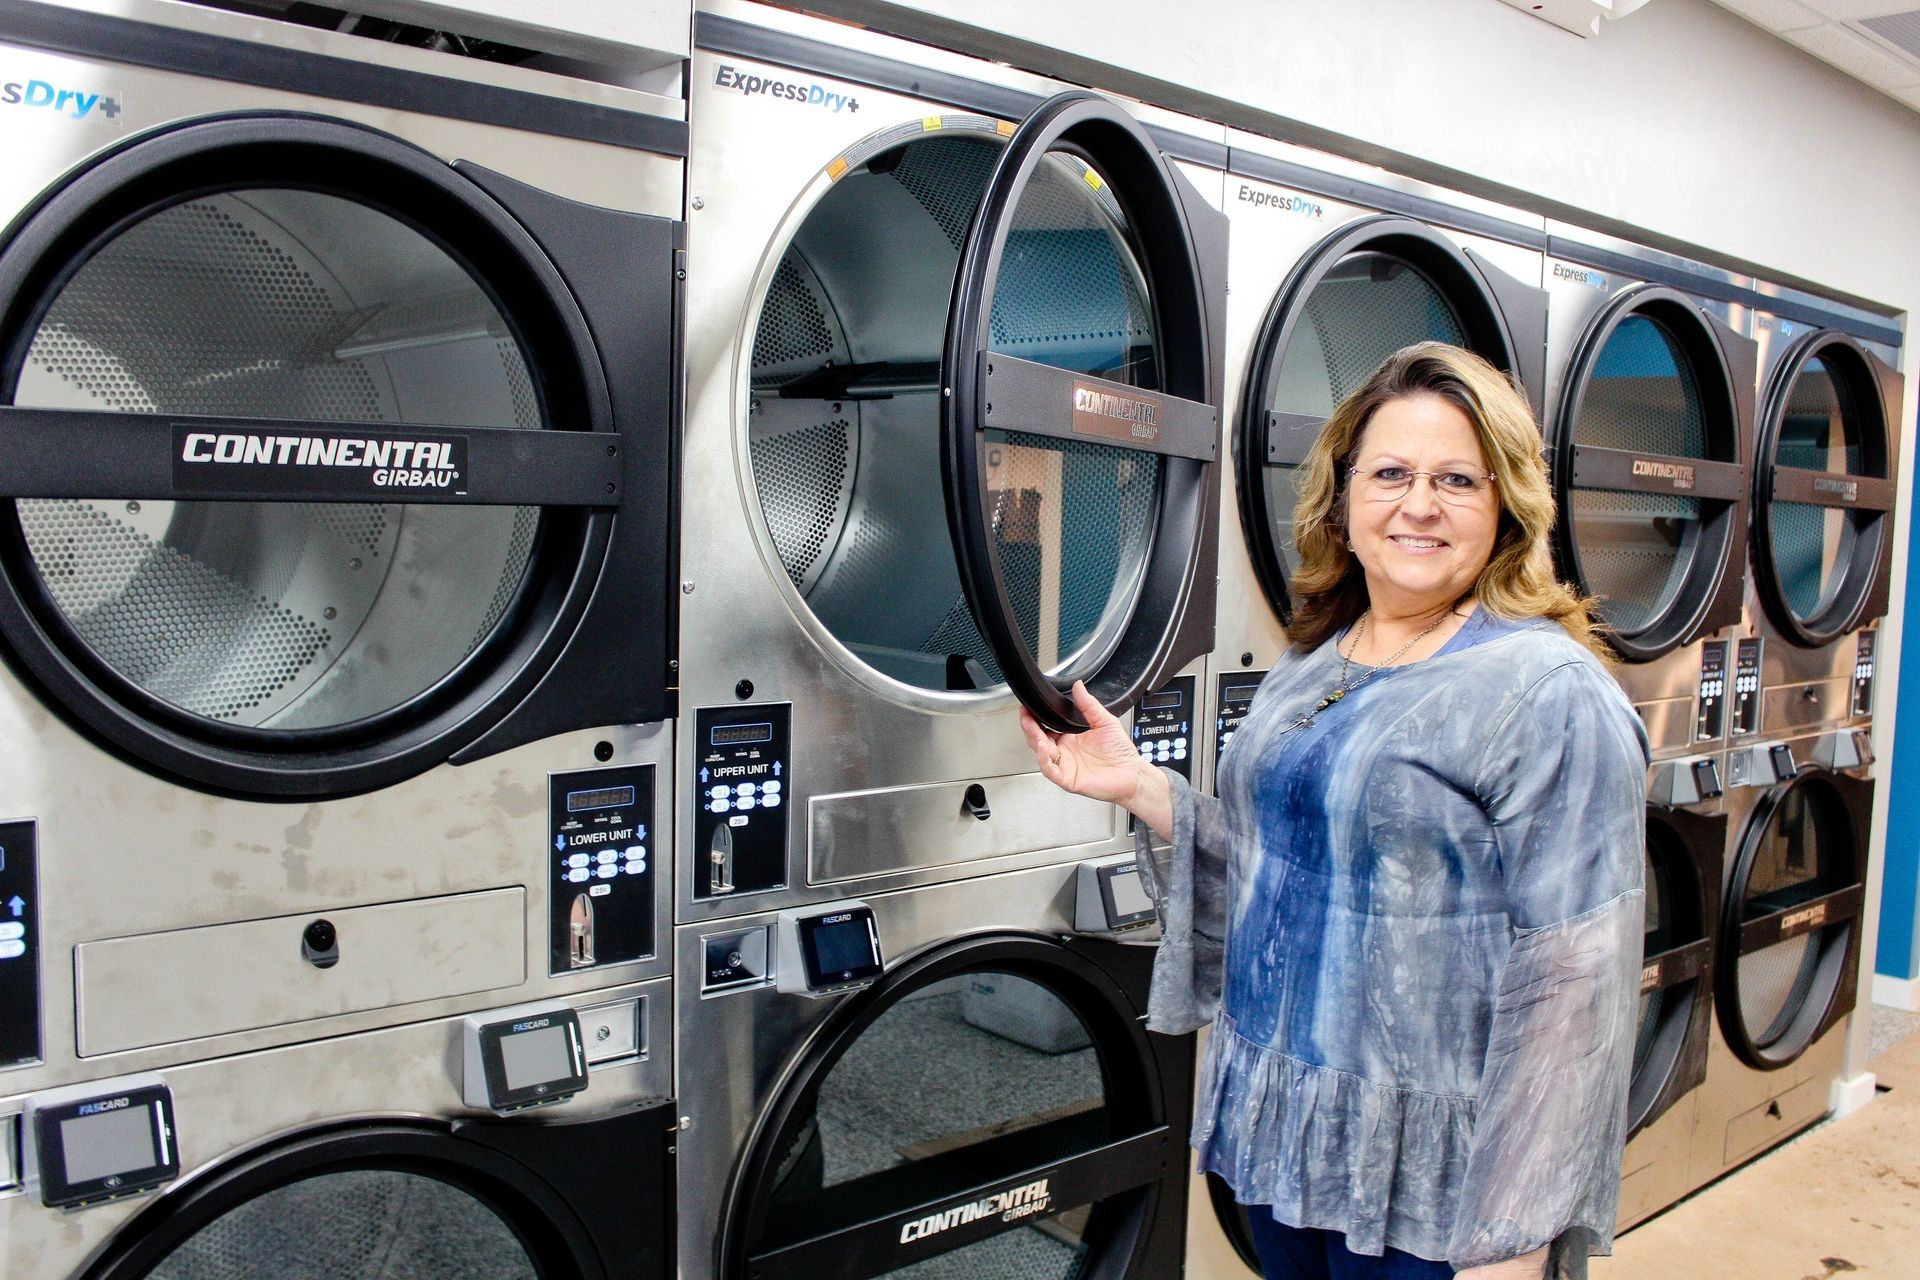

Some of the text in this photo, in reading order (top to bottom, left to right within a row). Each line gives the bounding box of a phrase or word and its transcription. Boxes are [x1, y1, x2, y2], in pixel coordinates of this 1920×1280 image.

[715, 64, 860, 113] ExpressDry+
[0, 79, 121, 119] sDry+
[1238, 184, 1322, 217] ExpressDry+
[1075, 387, 1157, 426] CONTINENTAL
[182, 433, 455, 469] CONTINENTAL
[1632, 460, 1694, 480] CONTINENTAL
[1142, 724, 1180, 736] LOWER UNIT
[713, 763, 769, 778] UPPER UNIT
[569, 828, 633, 846] LOWER UNIT
[1117, 864, 1138, 874] FASCAR
[822, 914, 852, 924] FASCARD
[513, 1018, 550, 1032] FASCARD
[78, 1097, 130, 1116] FASCARD
[900, 1178, 1050, 1245] CONTINENTAL
